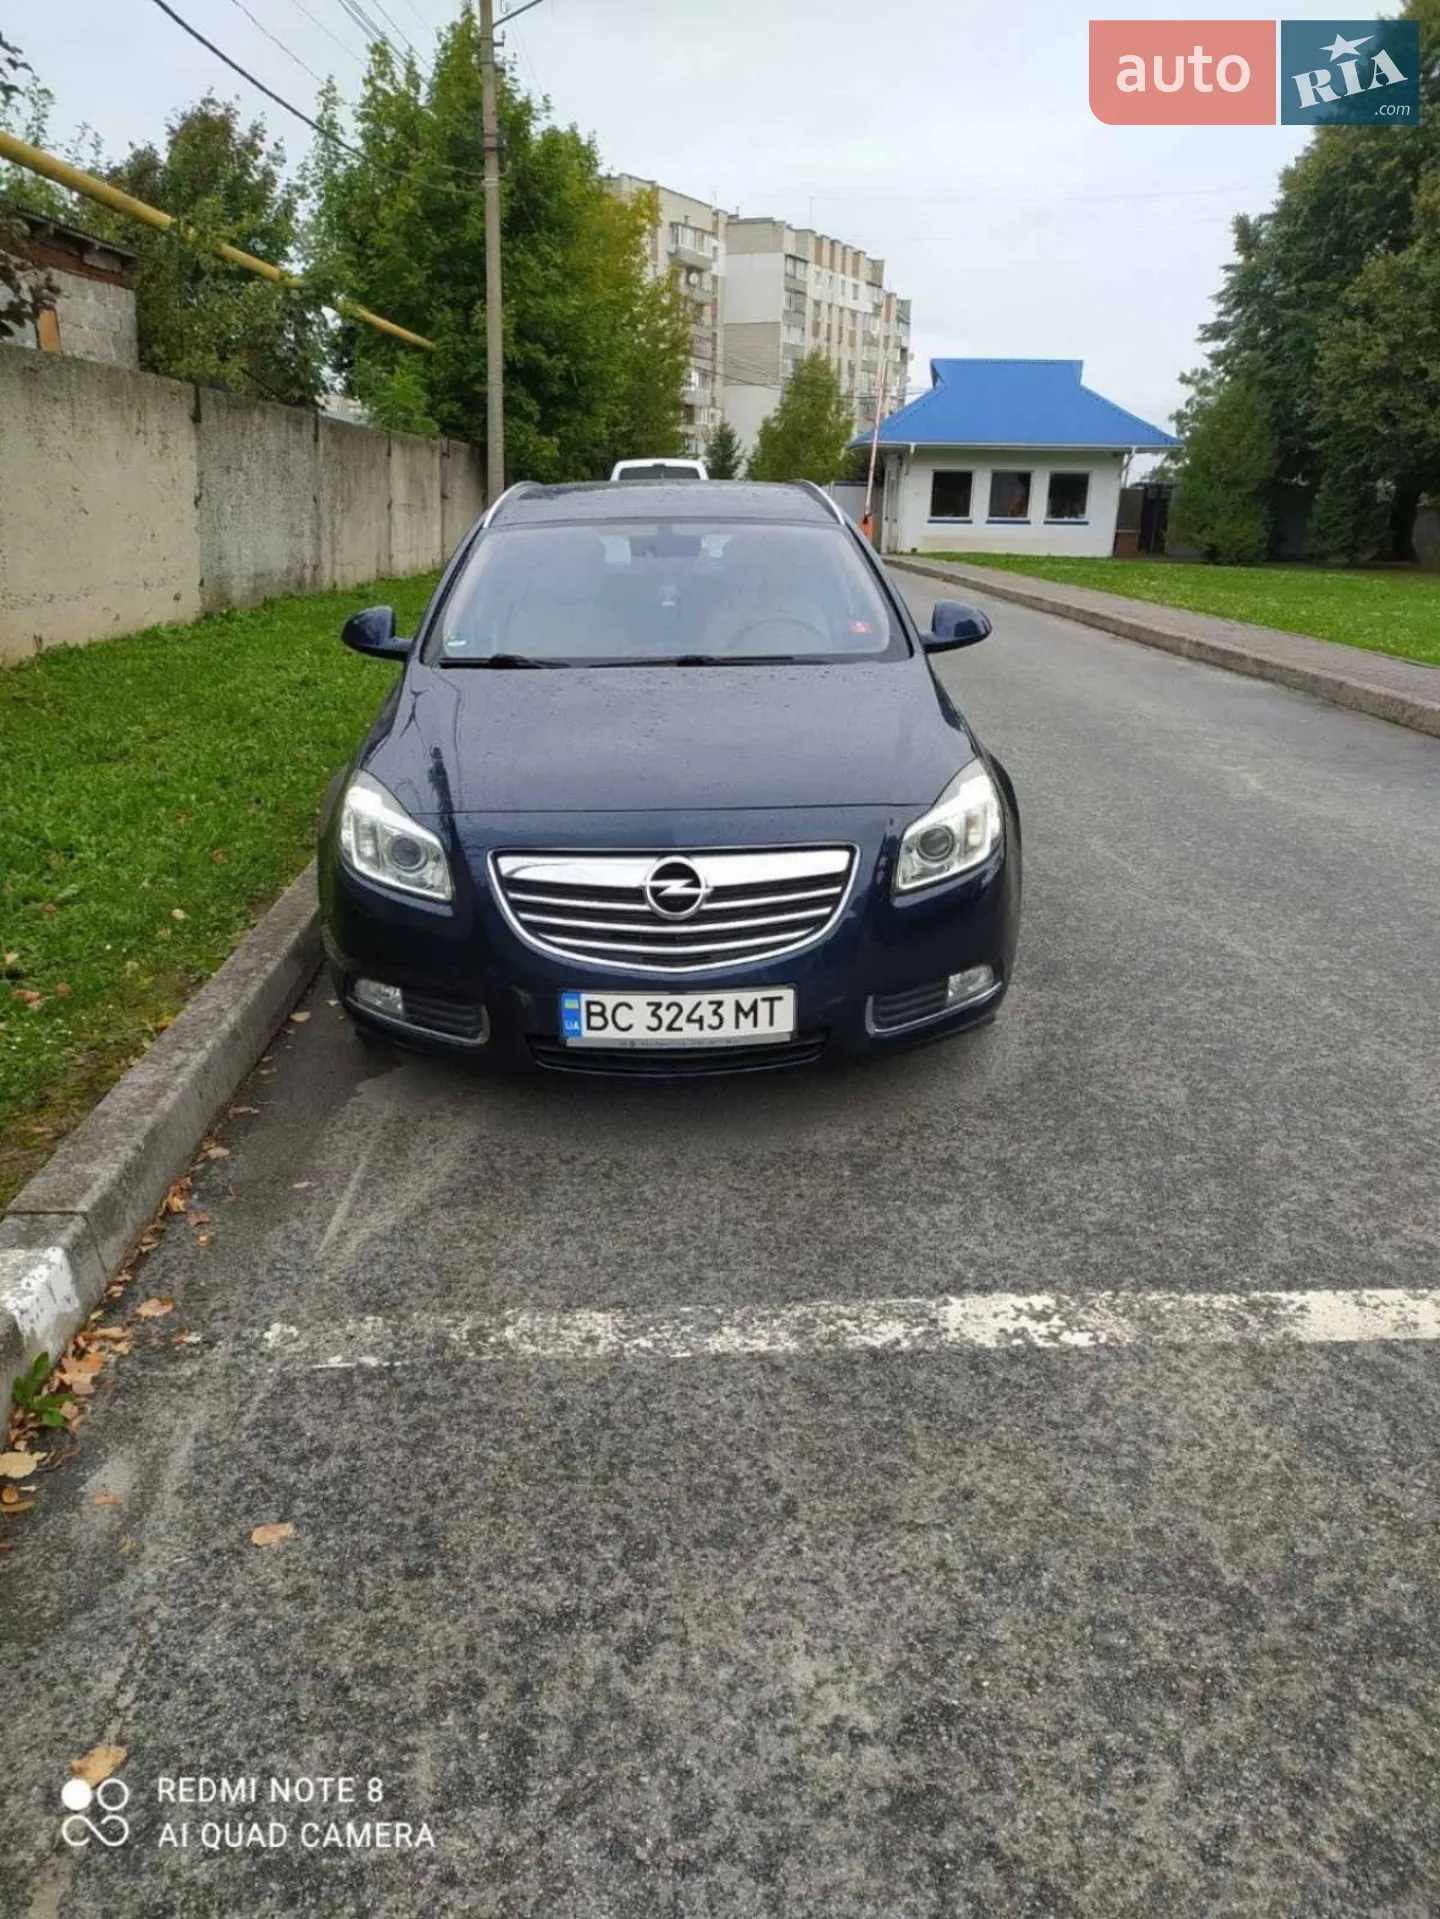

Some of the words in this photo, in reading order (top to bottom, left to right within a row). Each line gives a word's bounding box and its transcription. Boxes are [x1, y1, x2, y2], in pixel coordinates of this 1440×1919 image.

[565, 1020, 580, 1031] UA
[585, 1000, 634, 1032] BC
[646, 1000, 724, 1032] 3243
[734, 996, 784, 1030] MT
